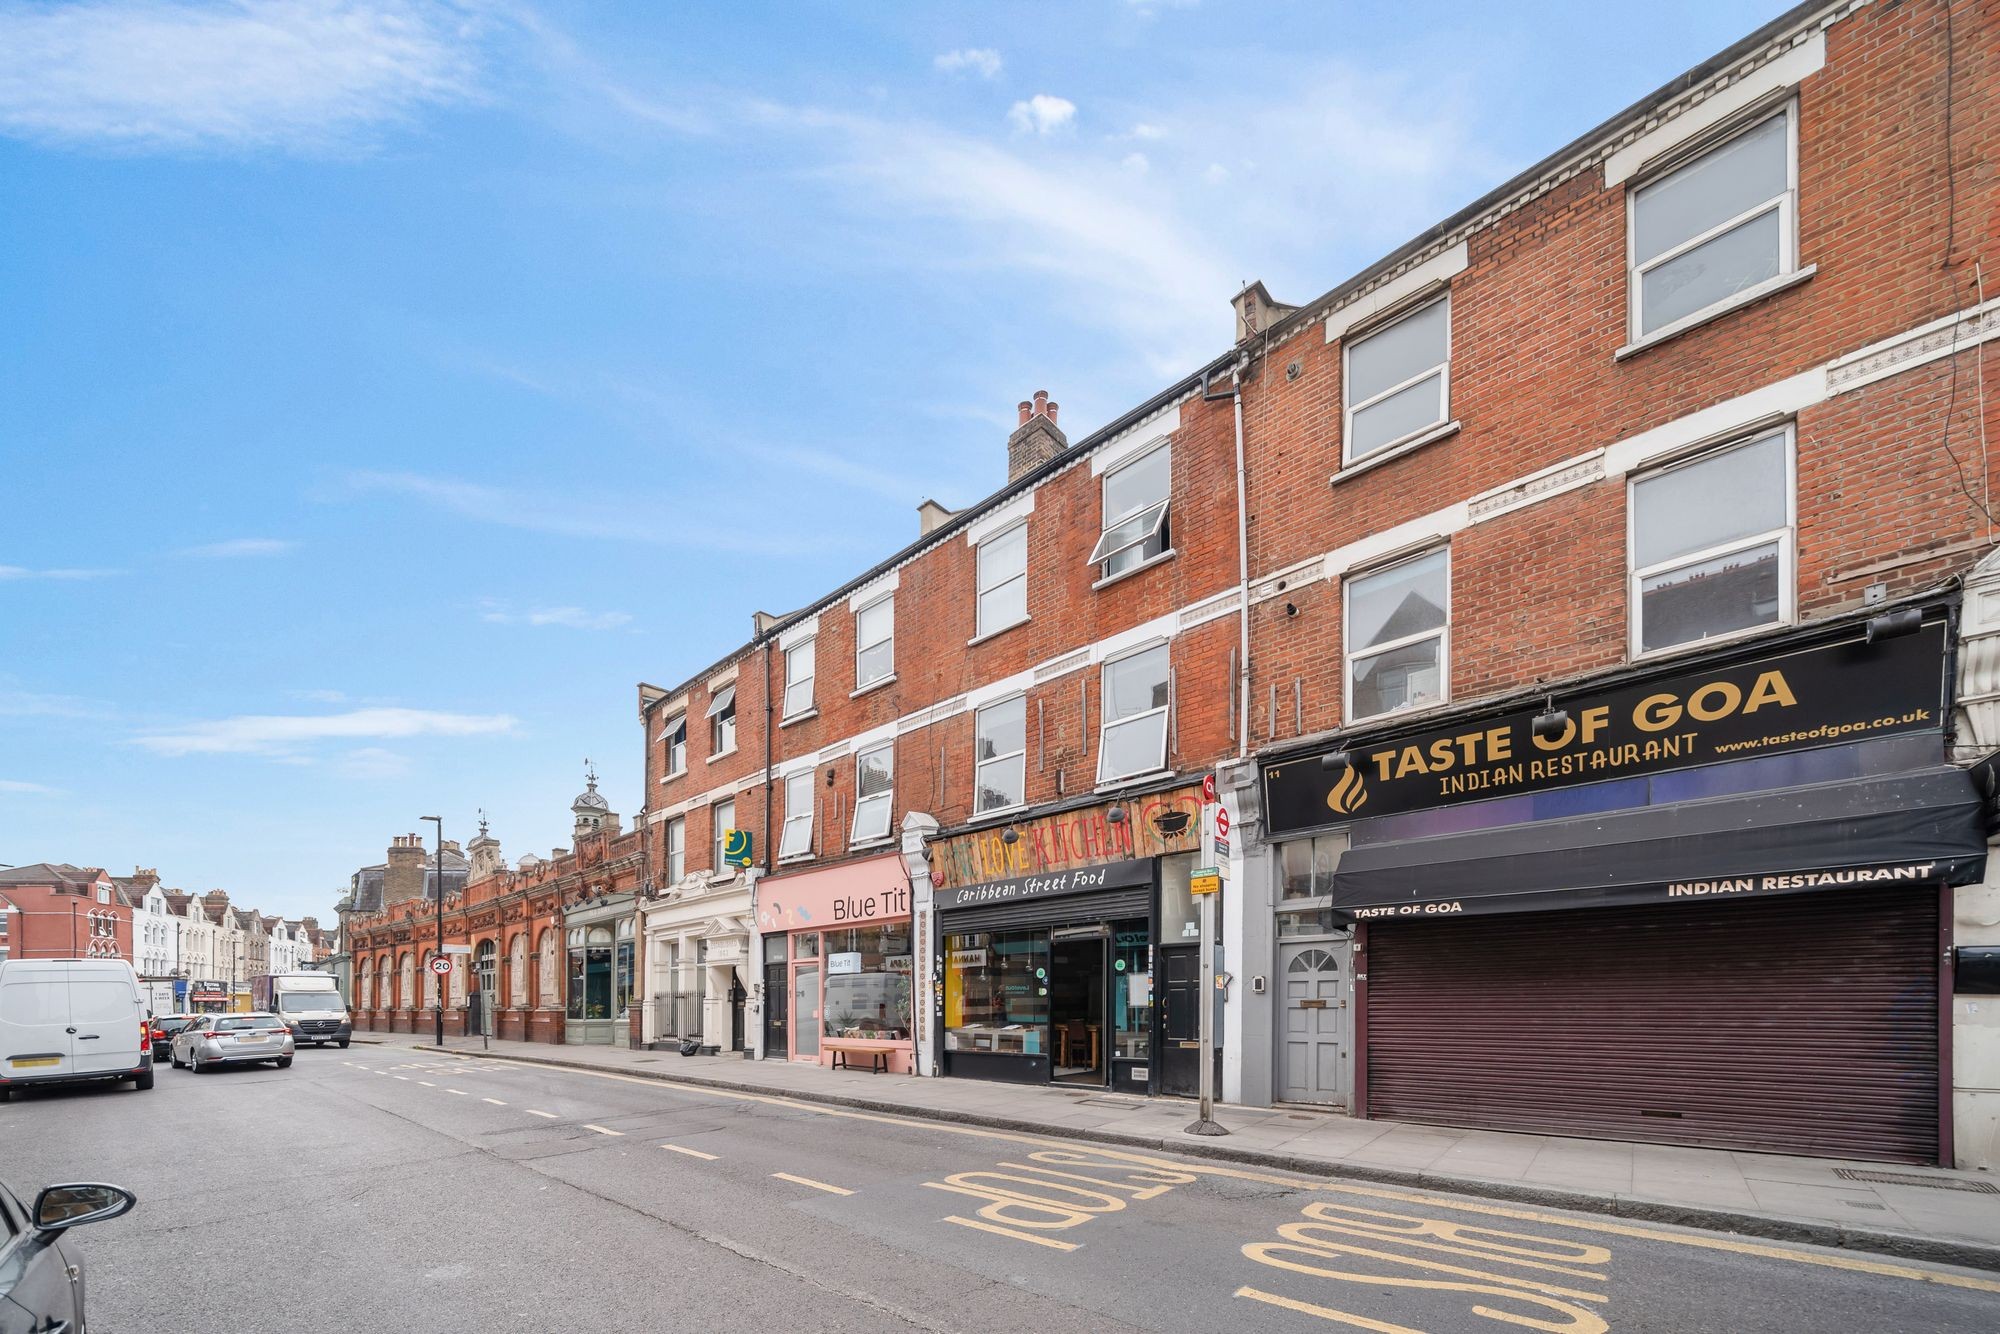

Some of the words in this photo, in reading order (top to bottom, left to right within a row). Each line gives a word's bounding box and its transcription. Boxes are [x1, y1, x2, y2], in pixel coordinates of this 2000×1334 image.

[1372, 726, 1512, 782] TASTE
[1532, 705, 1610, 751] OF
[1631, 670, 1798, 732] GOA
[1714, 709, 1930, 754] www.tasteofgoa.co.uk
[1268, 770, 1281, 779] 11
[1439, 763, 1524, 796] INDIAN
[1531, 732, 1699, 780] RESTAURANT
[980, 831, 1029, 876] LOVE
[1031, 808, 1132, 868] KITCHEN
[956, 885, 1016, 904] Caribbean
[1022, 874, 1067, 895] Street
[1072, 869, 1106, 889] Food
[1668, 879, 1754, 897] INDIAN
[1762, 865, 1935, 890] RESTAURANT
[833, 896, 876, 921] Blue
[880, 887, 907, 914] Tit
[1354, 907, 1395, 919] TASTE
[1400, 905, 1421, 915] OF
[1425, 902, 1463, 914] GOA
[435, 962, 450, 970] 20
[830, 960, 844, 968] Blue
[921, 1150, 1197, 1229] STOP
[1240, 1202, 1612, 1333] BUS
